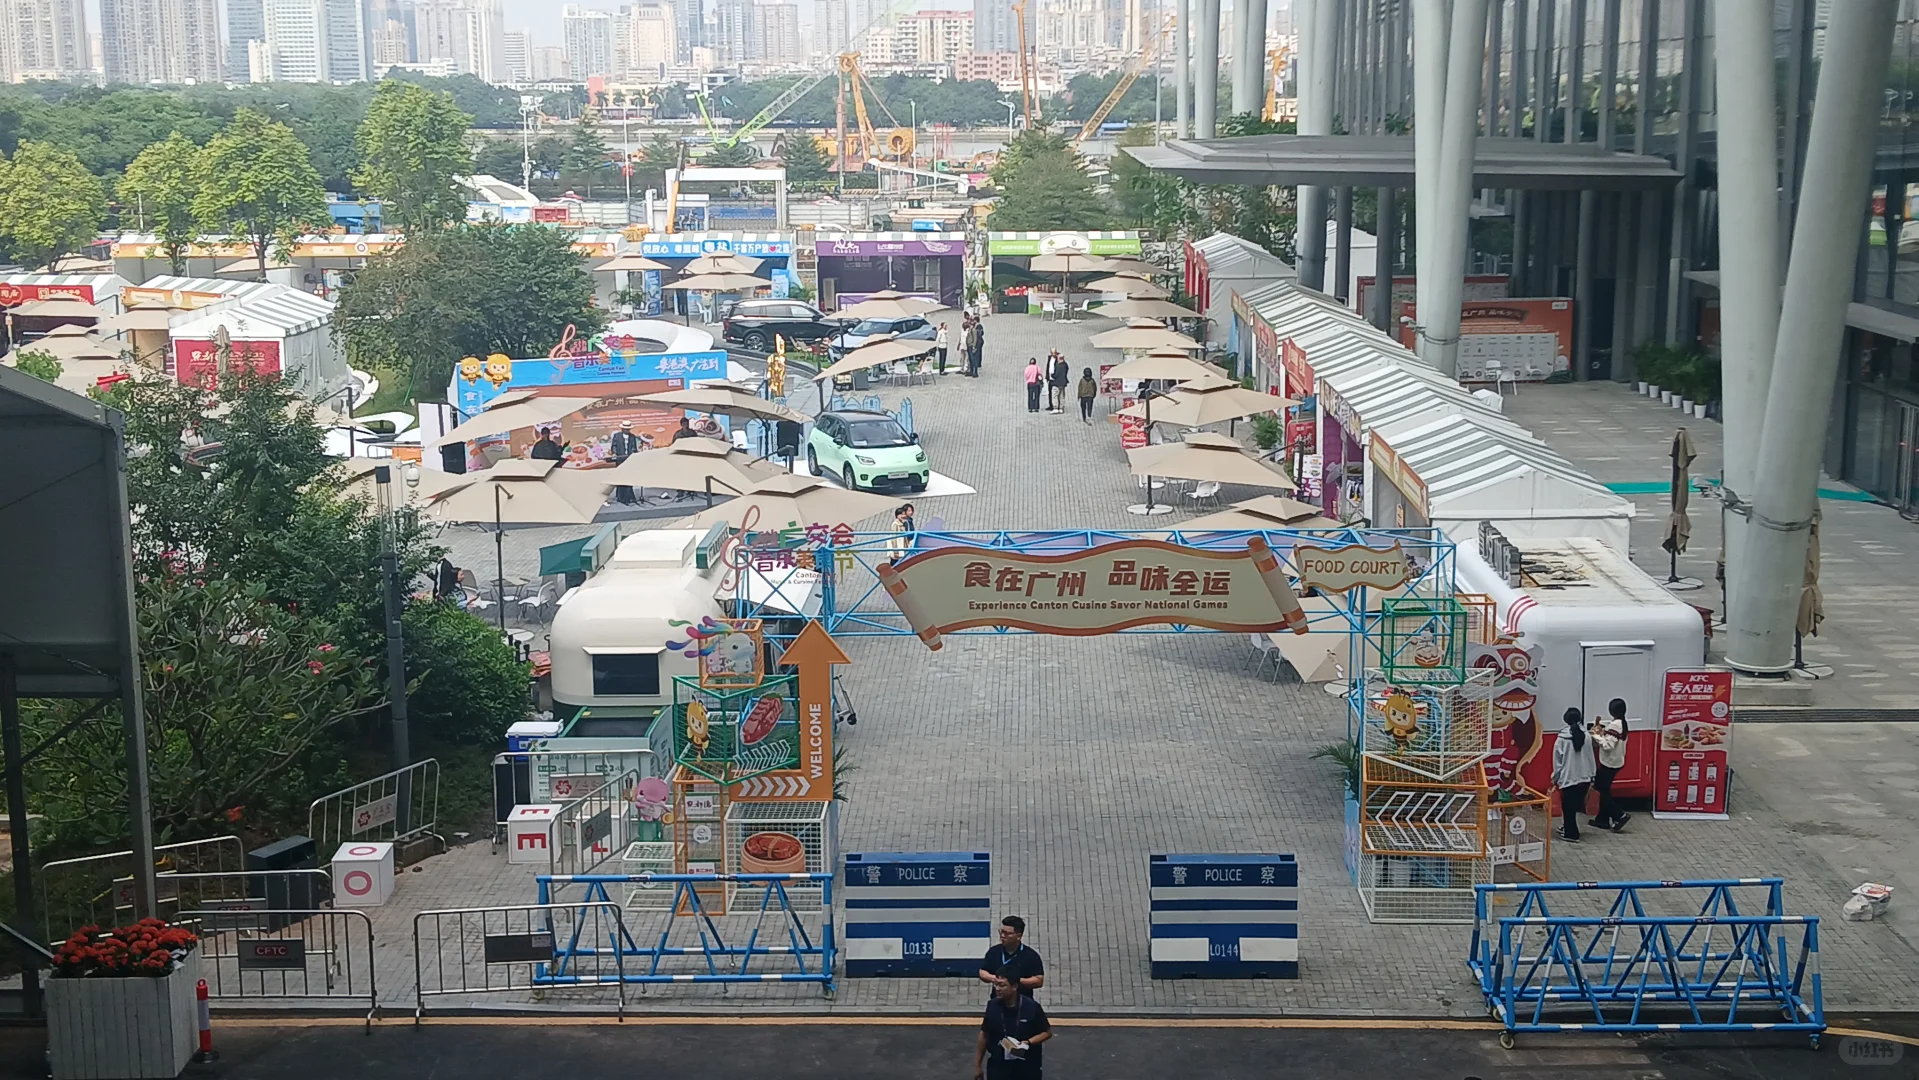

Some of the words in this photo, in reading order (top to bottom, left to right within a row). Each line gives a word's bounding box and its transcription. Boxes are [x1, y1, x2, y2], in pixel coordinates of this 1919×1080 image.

[780, 521, 854, 548] 广交会
[1304, 560, 1345, 574] FOOD
[1350, 560, 1402, 575] COURT
[963, 561, 1087, 597] 食在广州
[1107, 559, 1231, 596] 品味全运
[968, 600, 1027, 611] Experience
[1030, 600, 1068, 610] Canton
[1110, 600, 1141, 610] Savor
[1144, 600, 1190, 610] National
[1193, 600, 1228, 610] Games
[1669, 681, 1714, 693] 专人配送
[809, 703, 823, 779] WELCOME
[866, 865, 882, 884] 警
[899, 867, 936, 880] POLICE
[953, 864, 969, 883] 察
[1172, 866, 1188, 885] 警
[1205, 868, 1243, 882] POLICE
[1260, 865, 1276, 884] 察
[256, 946, 287, 956] CFTC
[903, 942, 932, 955] L0133
[1209, 943, 1239, 957] L0144
